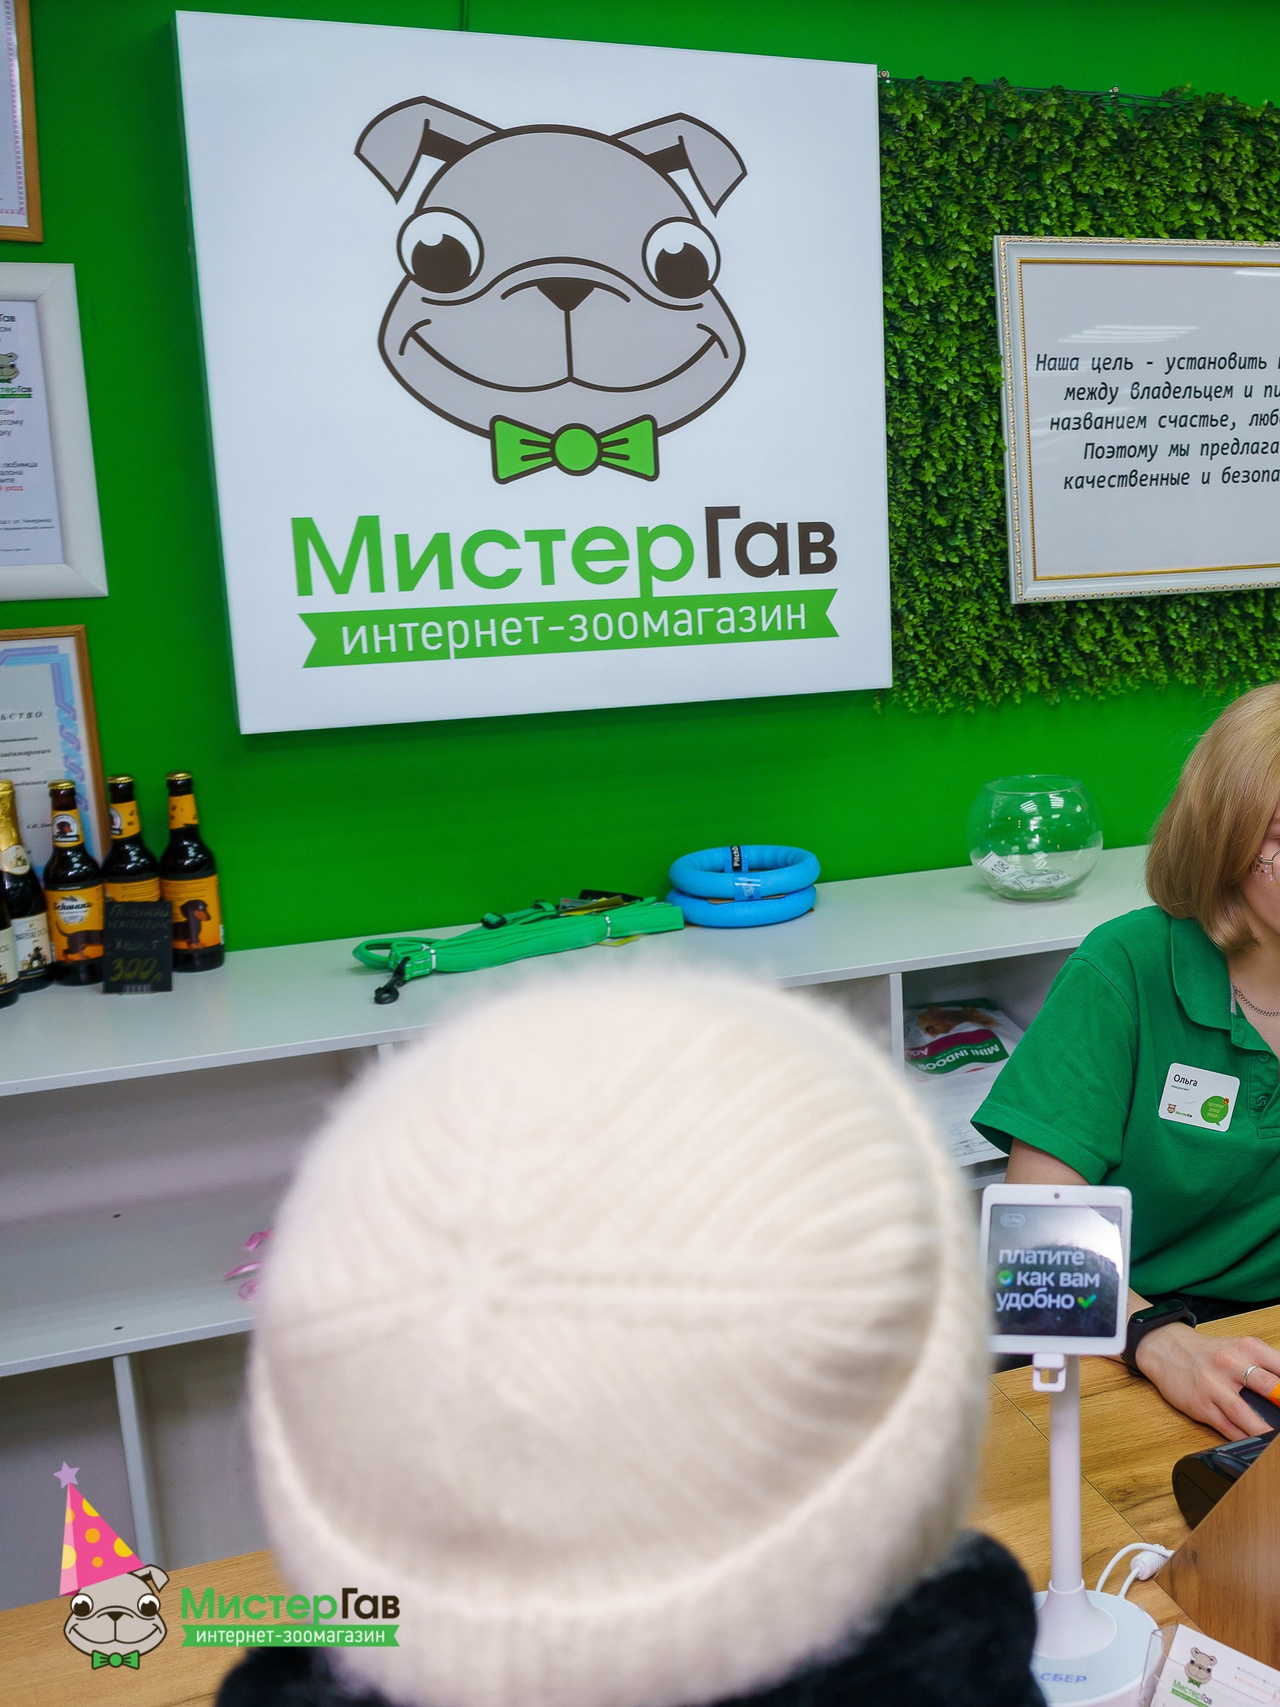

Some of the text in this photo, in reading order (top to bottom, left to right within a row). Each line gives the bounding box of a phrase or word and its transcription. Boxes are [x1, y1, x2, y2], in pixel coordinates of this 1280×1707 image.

[1035, 353, 1080, 371] Наша
[1091, 356, 1134, 374] цель
[1164, 351, 1267, 375] установить
[1063, 381, 1119, 405] между
[1130, 380, 1234, 402] владельцем
[1244, 385, 1253, 399] и
[1050, 411, 1147, 431] названием
[1158, 413, 1236, 431] счастье,
[1083, 442, 1159, 463] Поэтому
[1167, 443, 1190, 457] мы
[1063, 469, 1190, 490] качественные
[1201, 471, 1211, 485] и
[291, 505, 838, 599] МистерГав
[341, 602, 807, 660] интернет-зоомагазин
[53, 902, 93, 911] Schwanz
[918, 1044, 1000, 1071] MINI INDOOR
[1173, 1073, 1198, 1087] Ольга
[998, 1249, 1086, 1266] платите
[1016, 1270, 1100, 1288] как вам
[996, 1287, 1076, 1312] удобно
[1040, 1672, 1088, 1684] СБЕР
[1170, 1678, 1213, 1706] МистерГав
